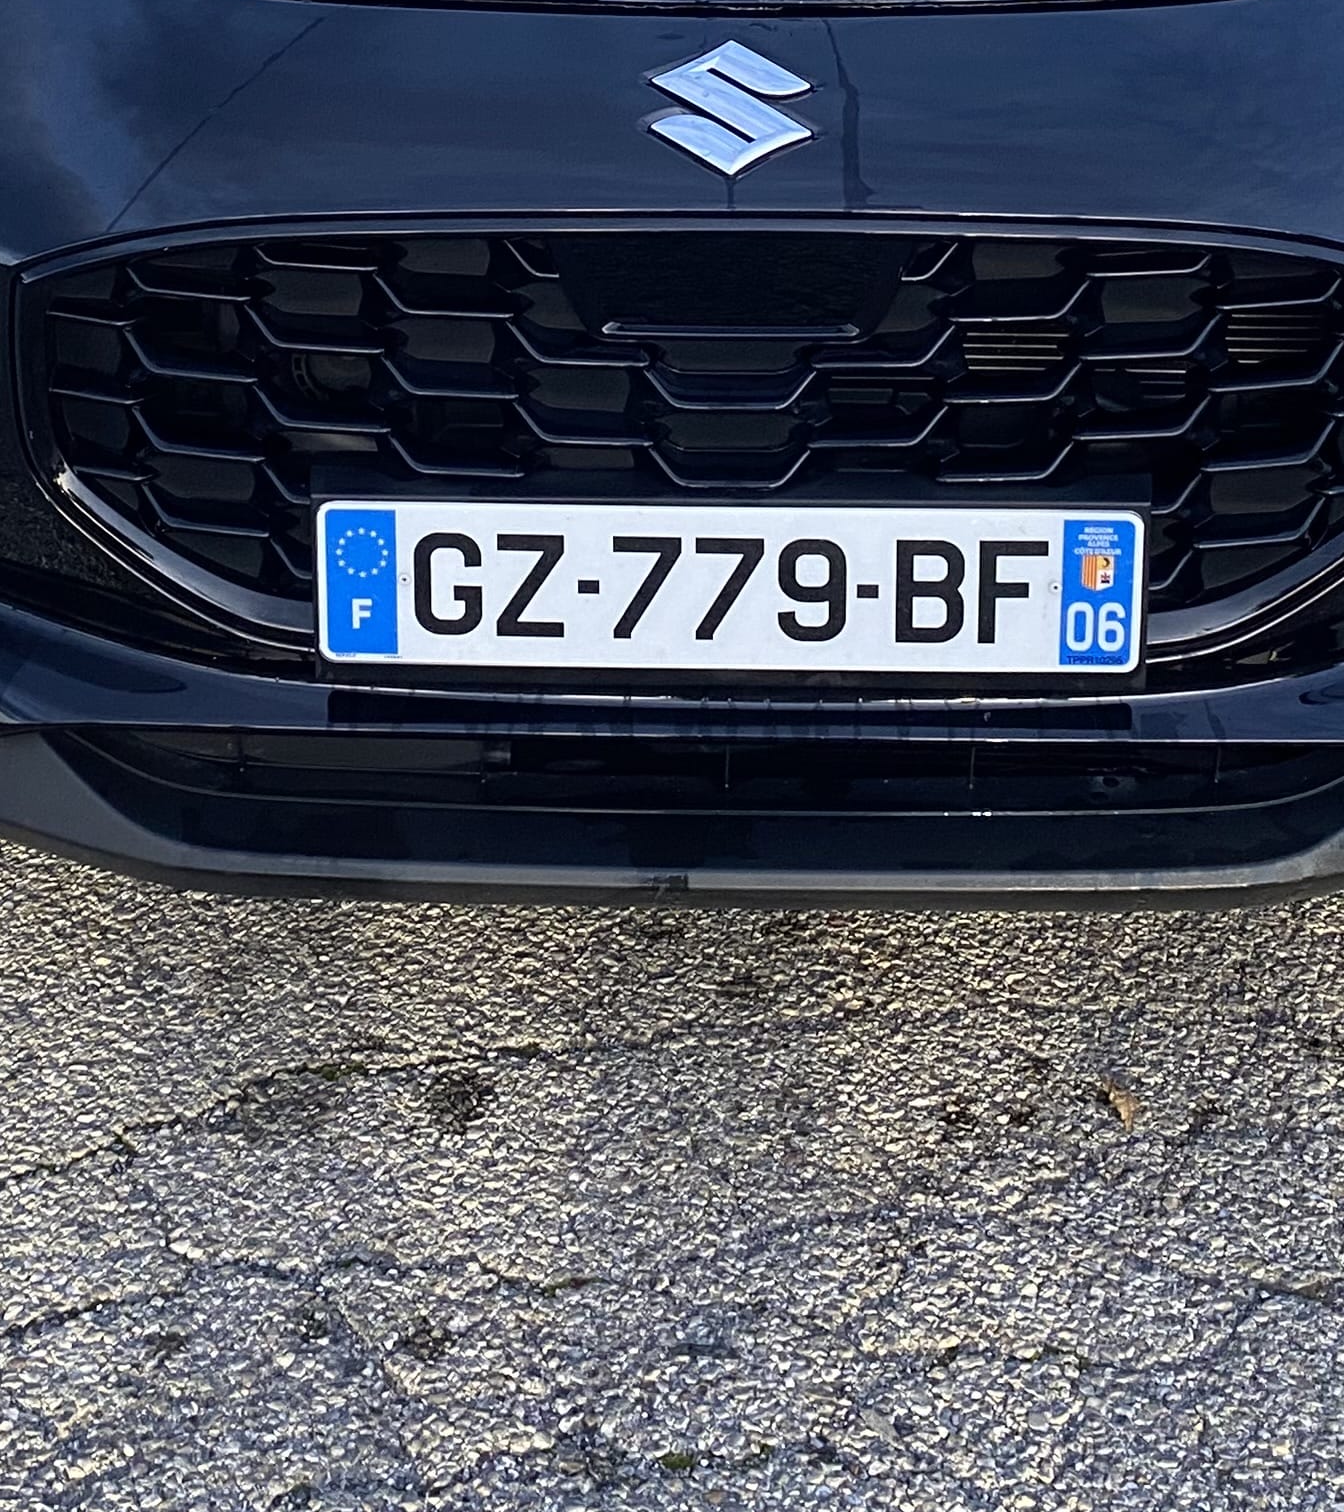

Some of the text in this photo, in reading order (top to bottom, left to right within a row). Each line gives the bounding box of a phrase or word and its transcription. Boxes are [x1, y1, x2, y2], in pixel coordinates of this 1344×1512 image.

[411, 531, 1049, 644] GZ-779-BF
[352, 598, 373, 629] F
[1066, 601, 1126, 652] 06
